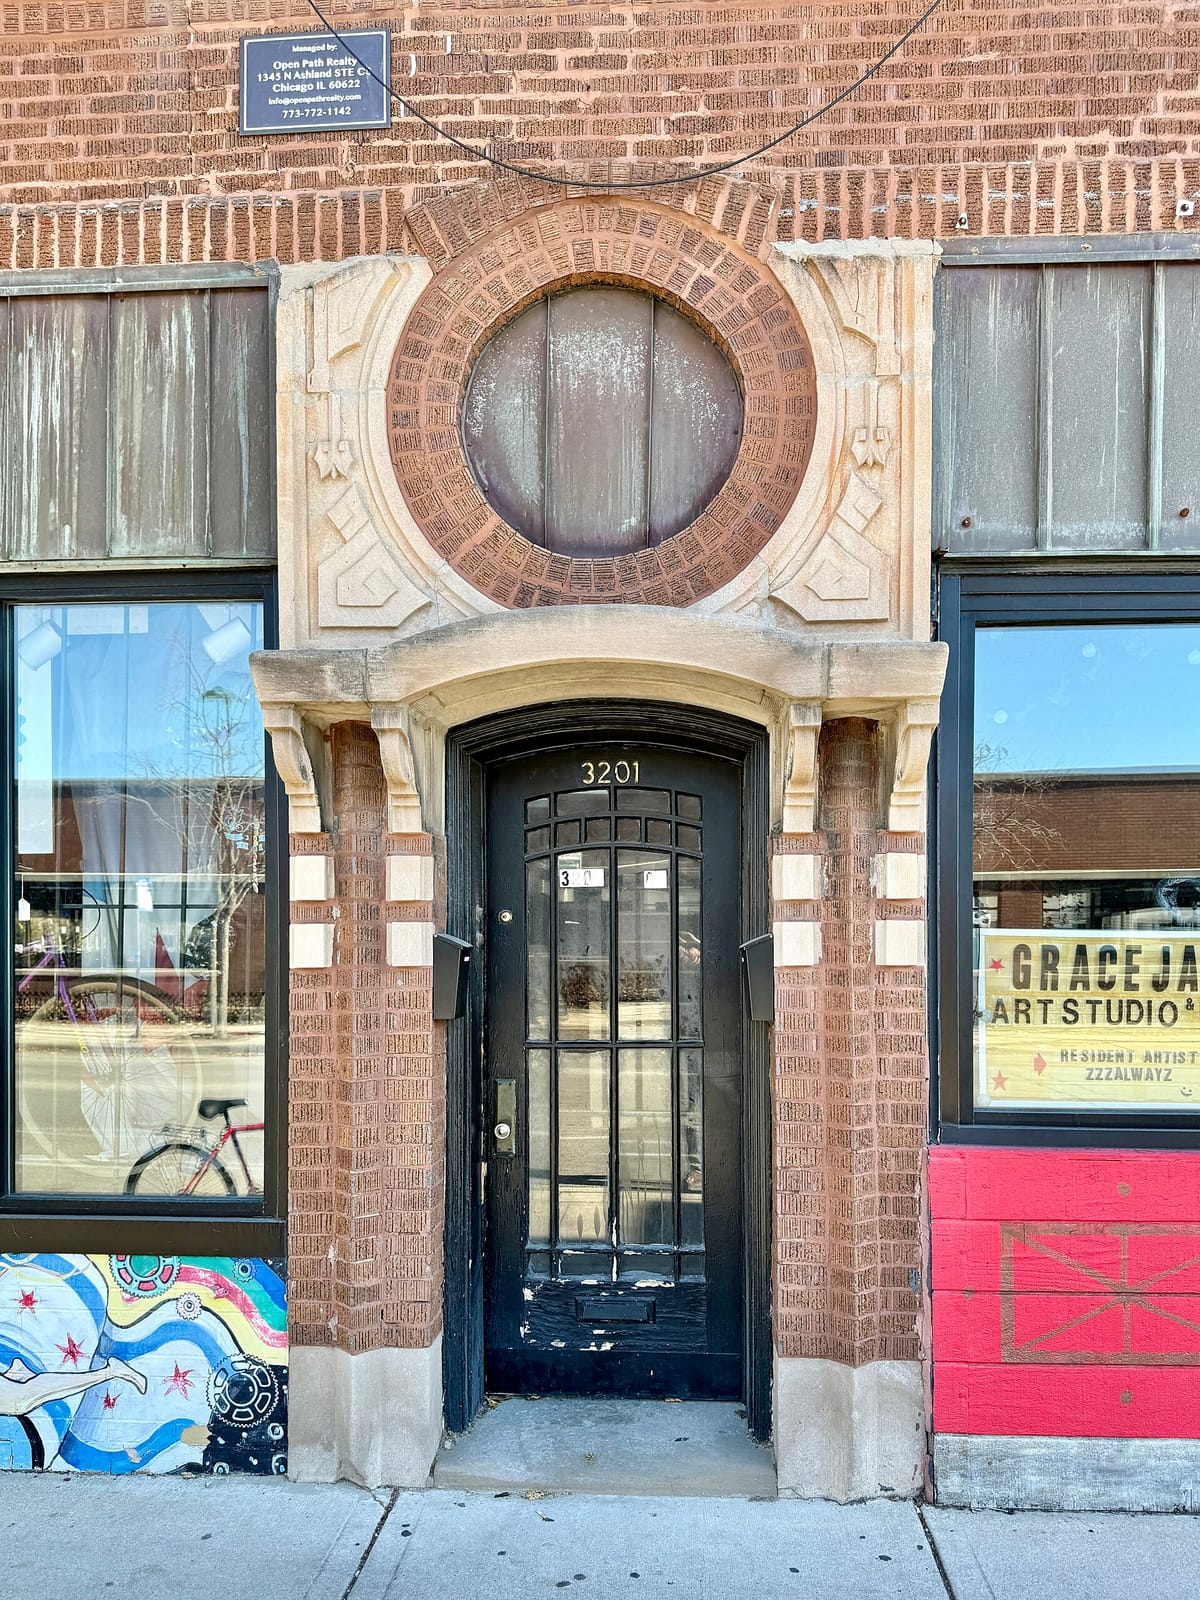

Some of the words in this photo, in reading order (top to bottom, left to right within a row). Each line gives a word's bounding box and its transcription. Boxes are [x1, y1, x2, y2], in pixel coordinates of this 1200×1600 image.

[292, 45, 326, 53] Managed
[327, 43, 338, 51] by:
[273, 60, 300, 71] Open
[302, 58, 324, 68] Path
[327, 56, 358, 66] Realty
[257, 73, 281, 82] 1345
[284, 71, 292, 80] N
[293, 69, 332, 80] Ashland
[334, 68, 355, 77] STE
[272, 82, 314, 93] Chicago
[316, 81, 327, 90] IL
[329, 79, 361, 89] 60622
[268, 94, 361, 105] info@openpathrealty.com
[282, 106, 352, 118] 773-772-1142
[581, 760, 641, 784] 3201
[1012, 943, 1143, 992] GRACE
[1151, 944, 1199, 993] JA
[991, 998, 1053, 1025] ART
[1061, 998, 1179, 1027] STUDIO
[1060, 1048, 1135, 1064] RESIDENT
[1143, 1049, 1199, 1065] ARTIST
[1085, 1067, 1173, 1082] ZZZALWAYZ
